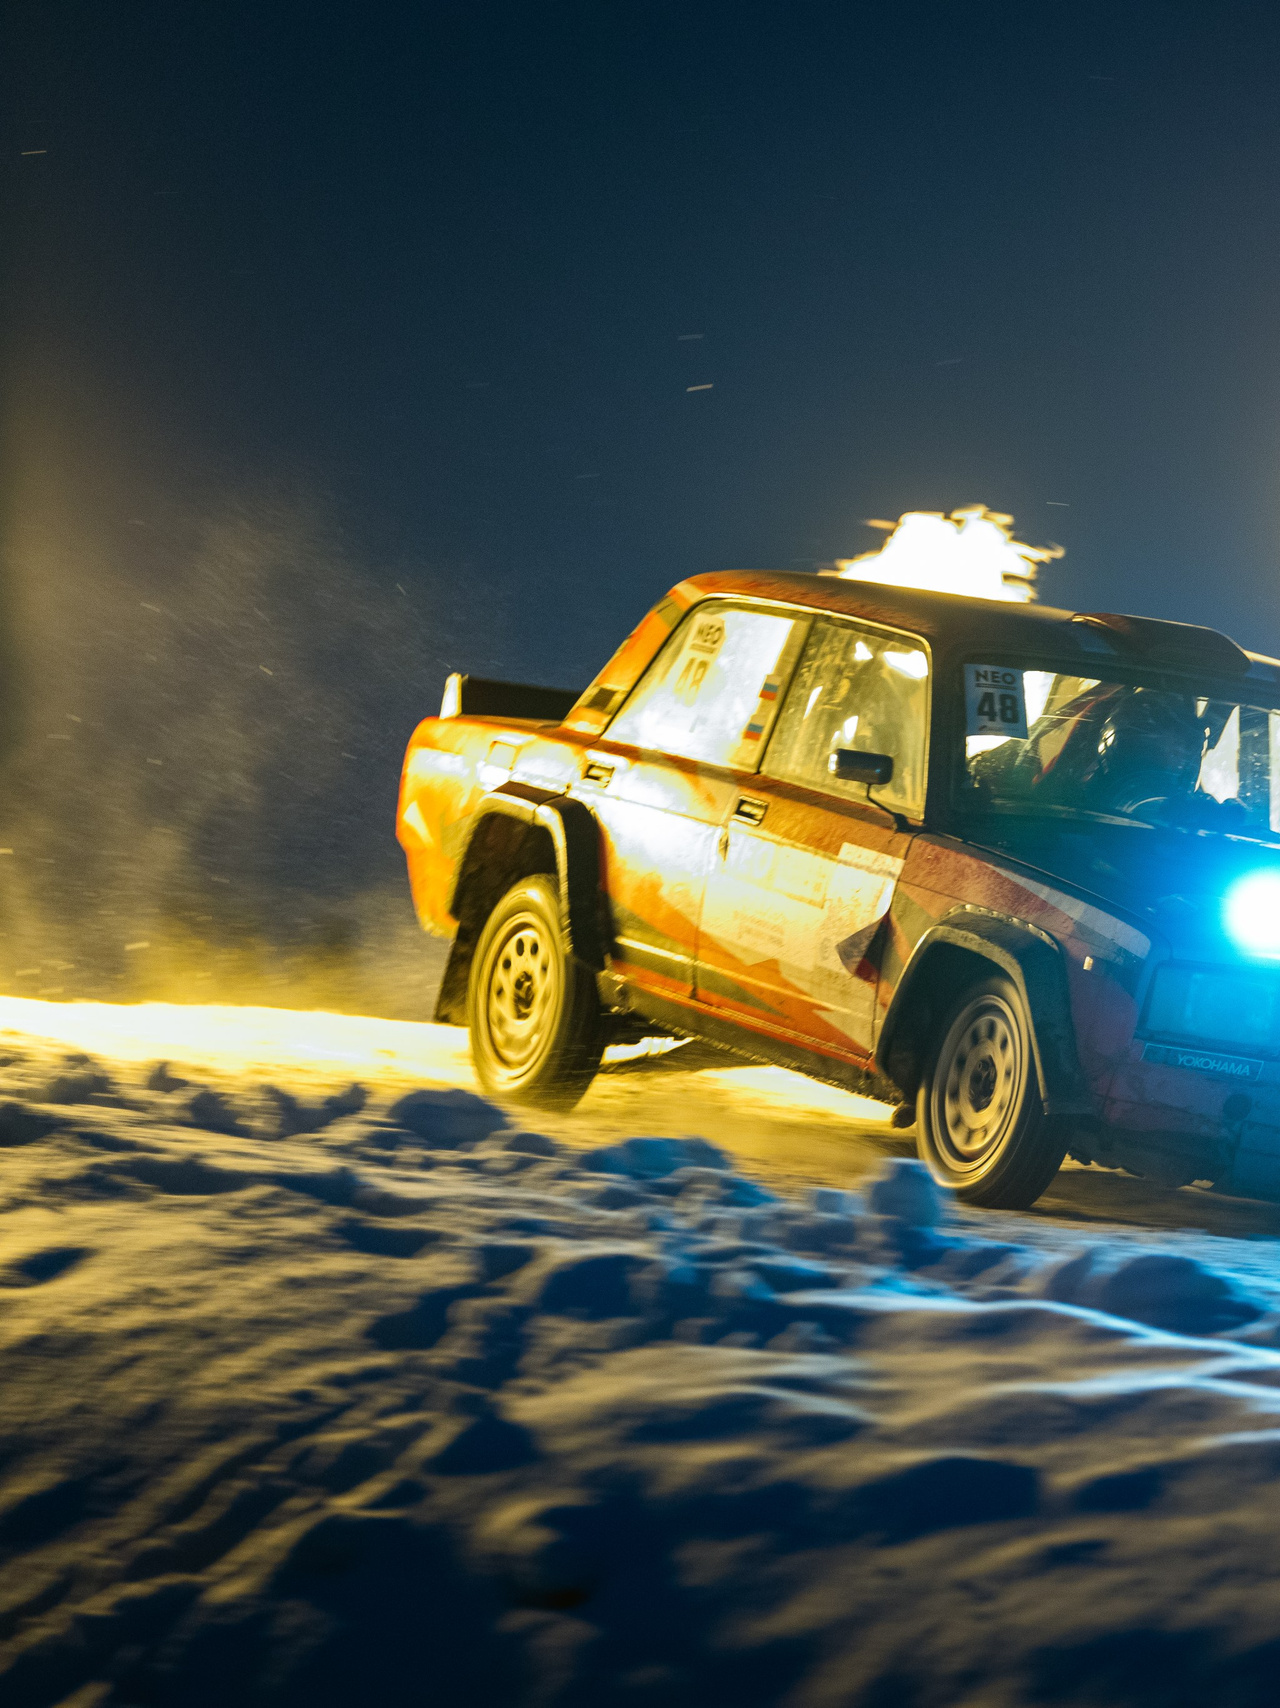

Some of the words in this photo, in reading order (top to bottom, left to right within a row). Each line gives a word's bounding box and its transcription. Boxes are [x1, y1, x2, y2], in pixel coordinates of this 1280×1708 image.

[974, 669, 1016, 685] NEO
[977, 691, 1020, 724] 48
[1177, 1054, 1251, 1077] YOKOHAMA
